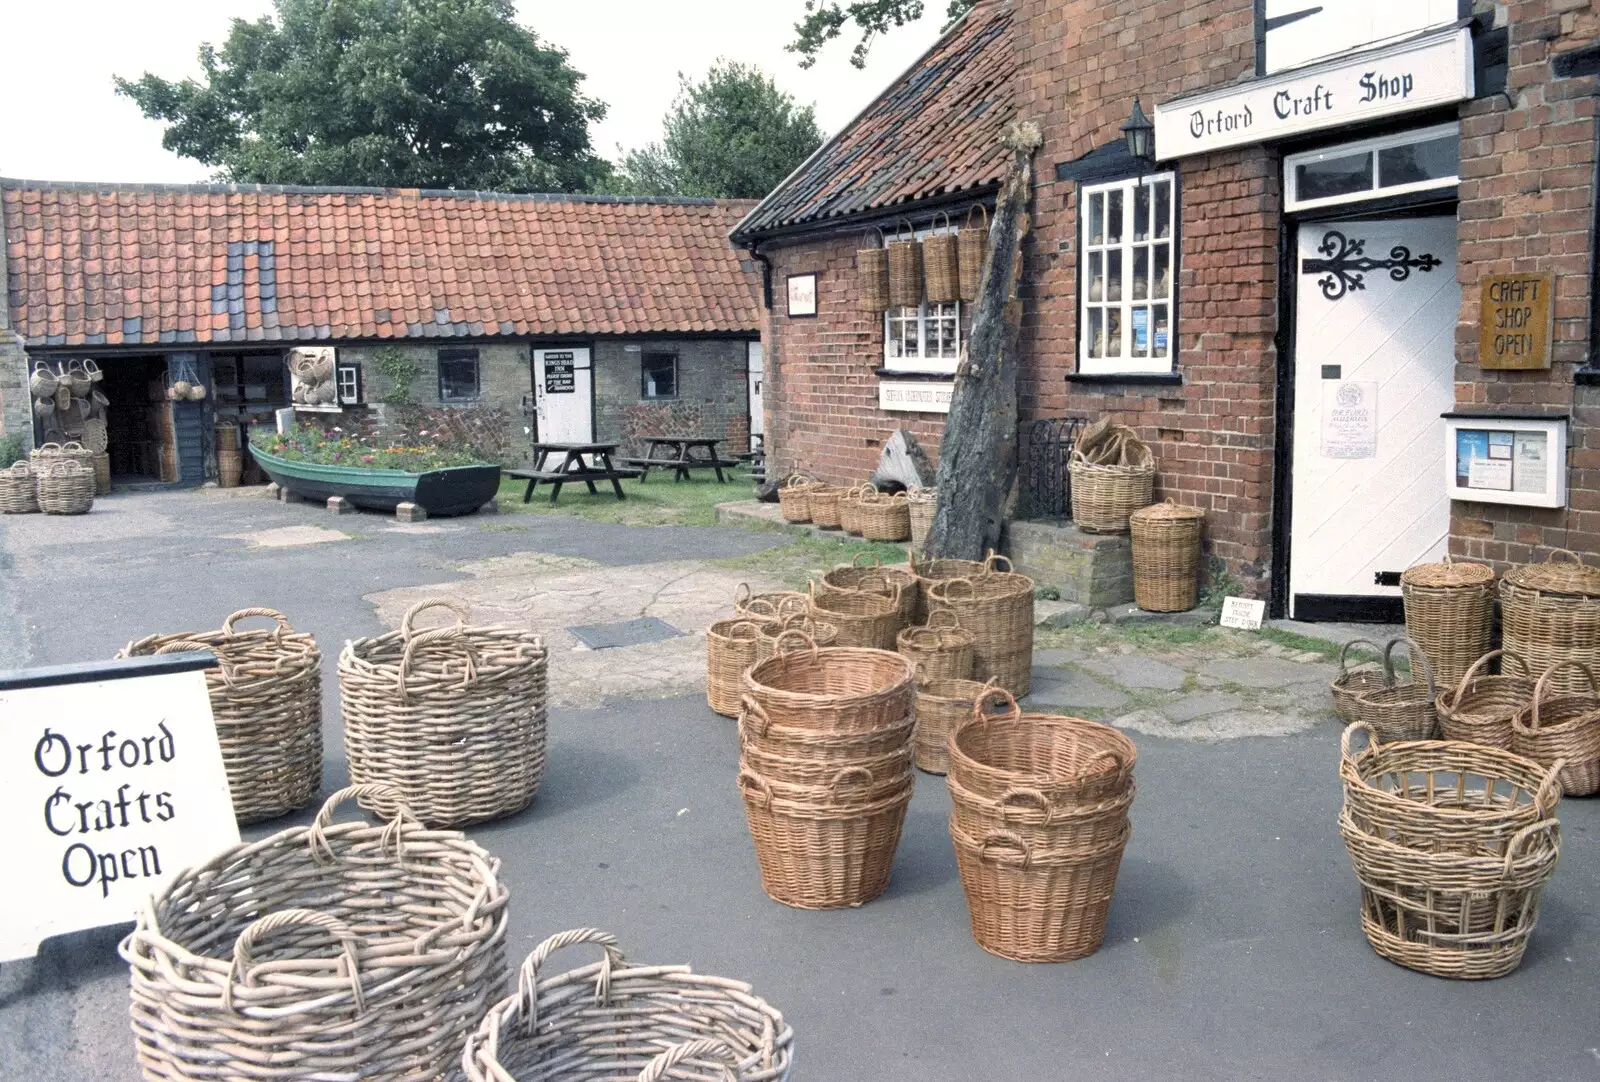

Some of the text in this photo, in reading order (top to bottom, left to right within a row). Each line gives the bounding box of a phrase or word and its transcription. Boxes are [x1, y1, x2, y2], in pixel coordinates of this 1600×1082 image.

[1189, 70, 1414, 139] Orford Craft Shop
[1489, 279, 1542, 302] CRAFT
[1495, 306, 1532, 329] SHOP
[1494, 333, 1533, 355] OPEN
[34, 717, 175, 777] Orford
[44, 783, 175, 837] Crafts
[62, 842, 162, 900] Open
